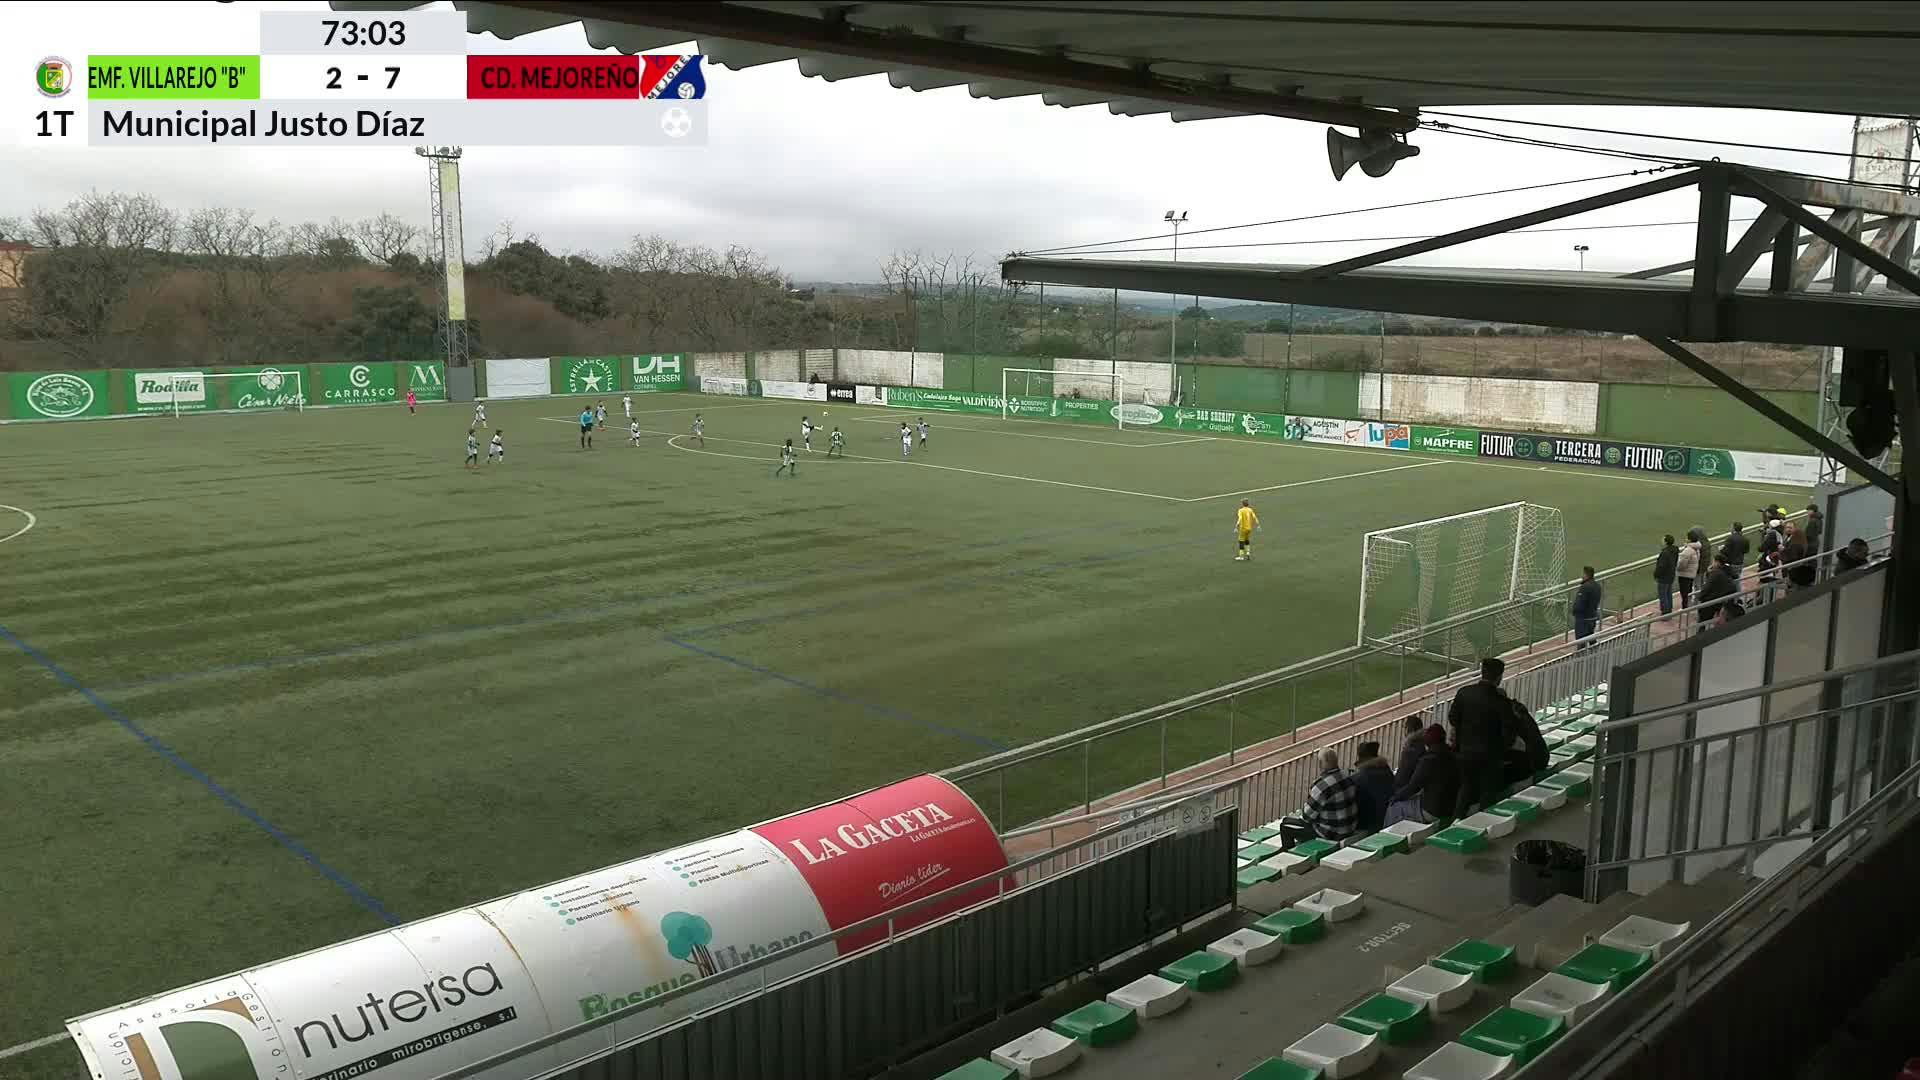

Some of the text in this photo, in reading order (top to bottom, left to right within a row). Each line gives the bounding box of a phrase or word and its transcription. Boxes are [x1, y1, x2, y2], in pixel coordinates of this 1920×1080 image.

[633, 373, 681, 384] VAN HESSEN
[140, 379, 200, 394] Rodilla
[325, 387, 396, 399] CARRASCO
[1368, 423, 1409, 447] lupa
[1423, 437, 1474, 450] MAPFRE
[1555, 440, 1601, 459] TERCERA
[1554, 456, 1602, 465] FEDERACIÓN
[789, 802, 954, 866] LA GACETA
[878, 875, 916, 899] Diario
[568, 901, 599, 913] Parques
[576, 907, 613, 922] Mobiliario
[292, 961, 504, 1059] nutersa
